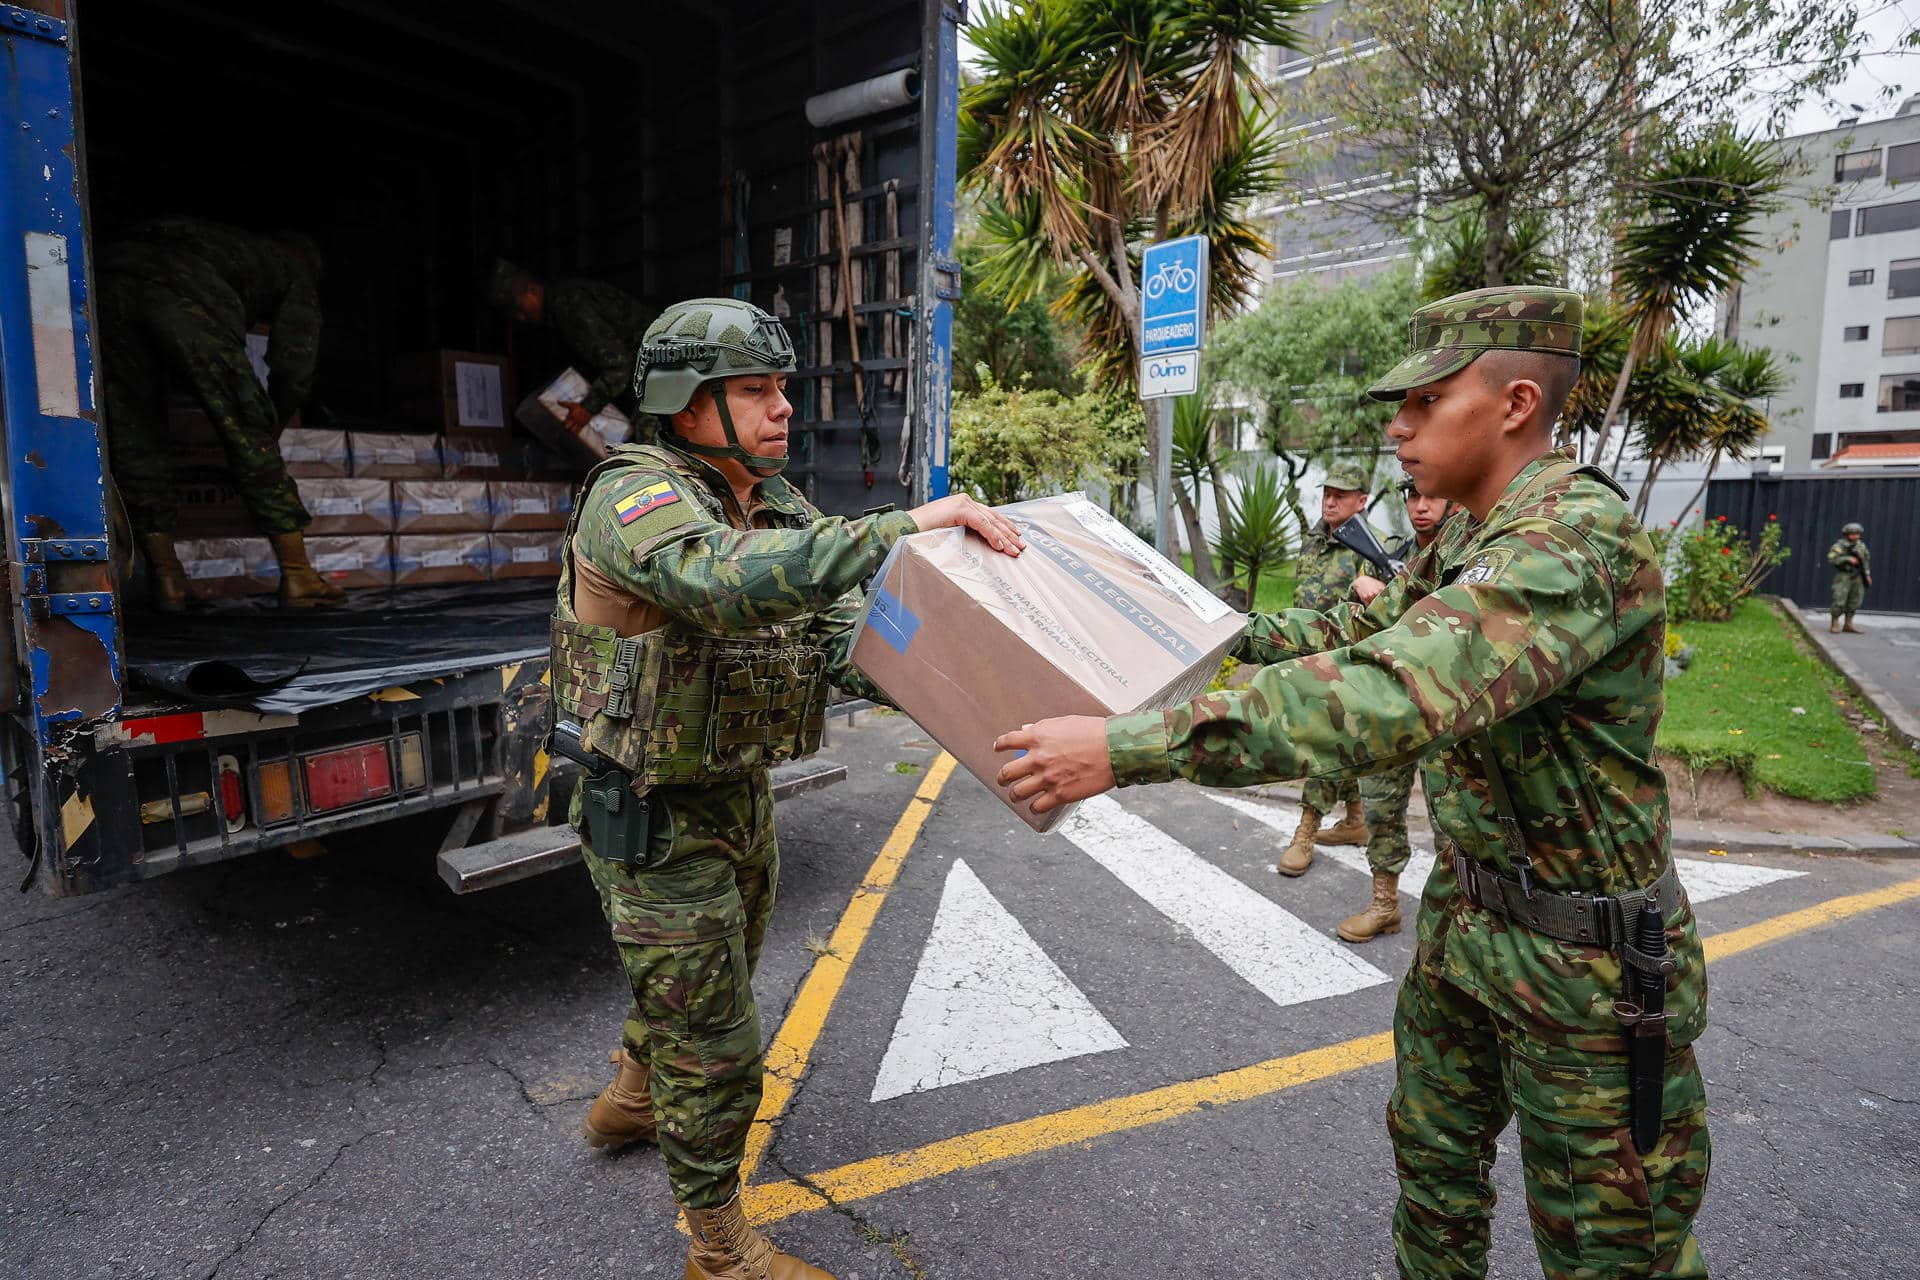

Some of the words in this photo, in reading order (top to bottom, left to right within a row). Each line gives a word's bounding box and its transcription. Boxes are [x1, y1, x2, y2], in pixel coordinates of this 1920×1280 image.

[1145, 323, 1193, 342] PARQUEADERO
[1013, 521, 1081, 570] AQUETE
[1083, 572, 1187, 656] ELECTORAL
